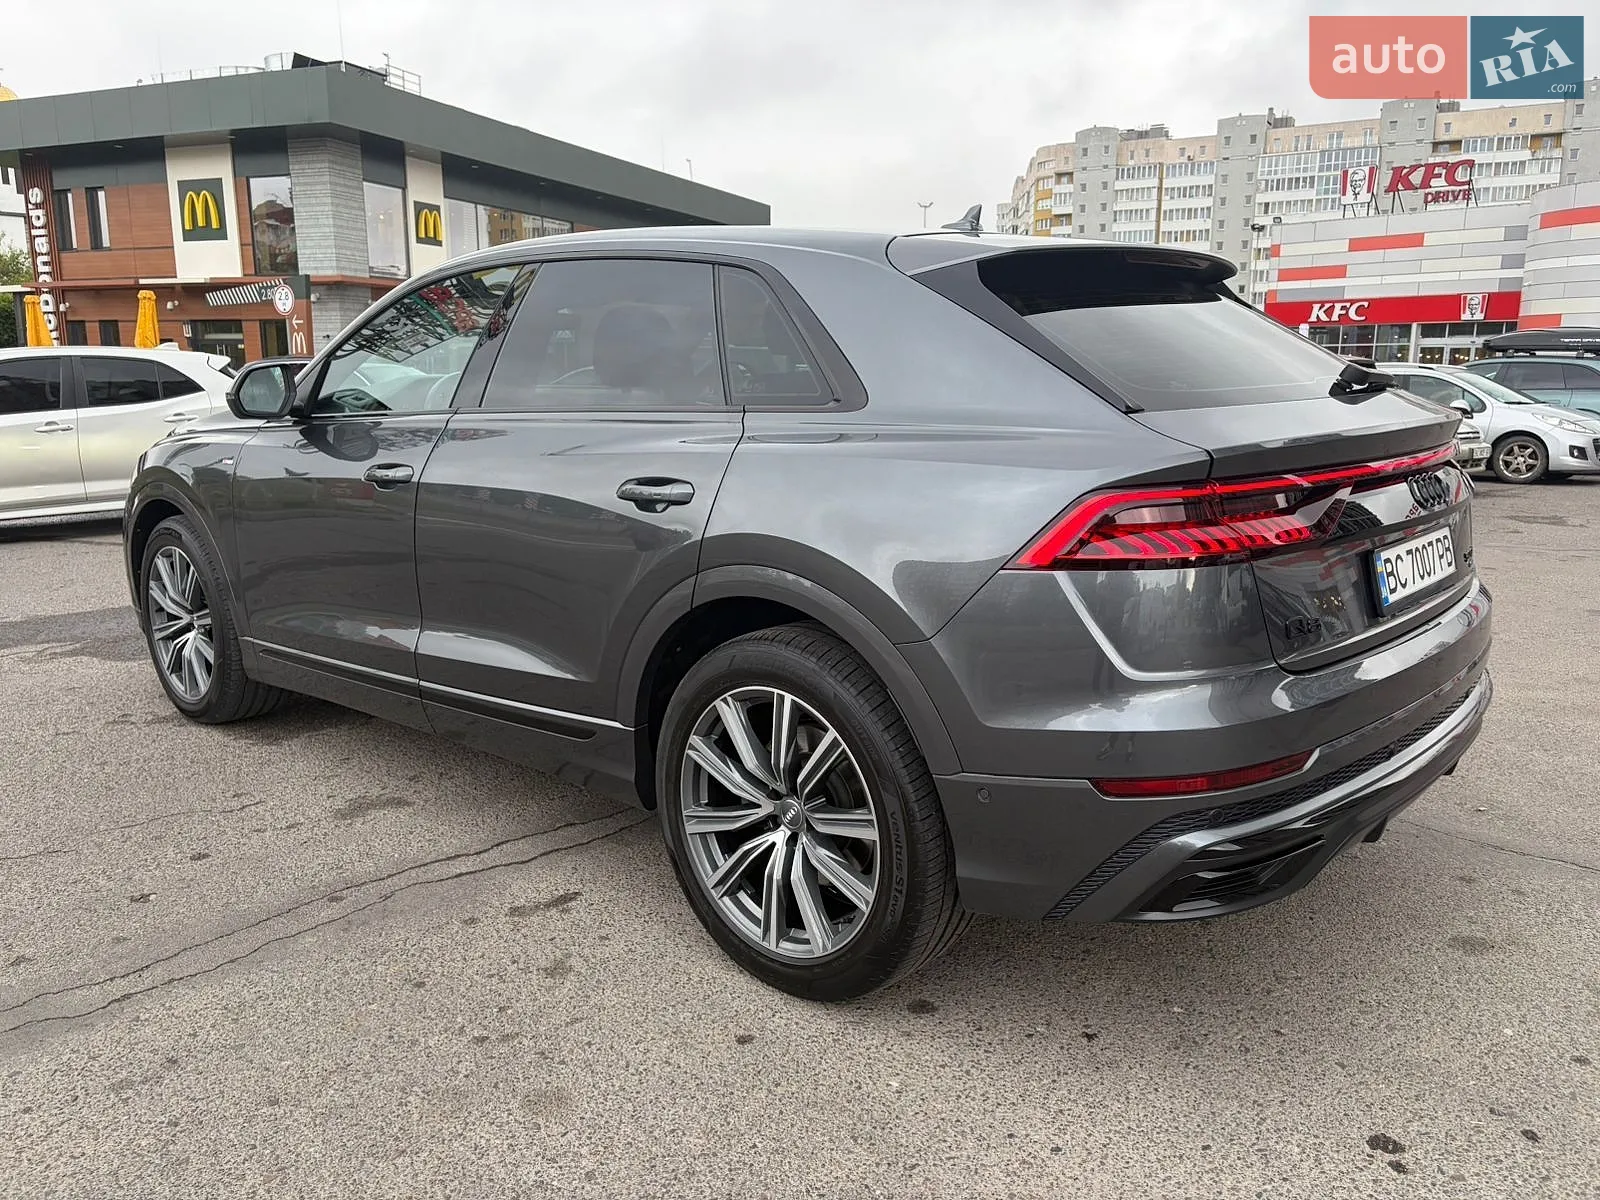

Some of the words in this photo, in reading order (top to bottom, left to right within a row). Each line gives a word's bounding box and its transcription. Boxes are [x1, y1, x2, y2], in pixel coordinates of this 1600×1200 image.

[1384, 159, 1475, 192] KFC
[1423, 188, 1472, 204] DRIVE
[1308, 301, 1369, 323] KFC
[1383, 553, 1408, 595] BC
[1405, 541, 1436, 585] 7007
[1435, 534, 1453, 571] PB
